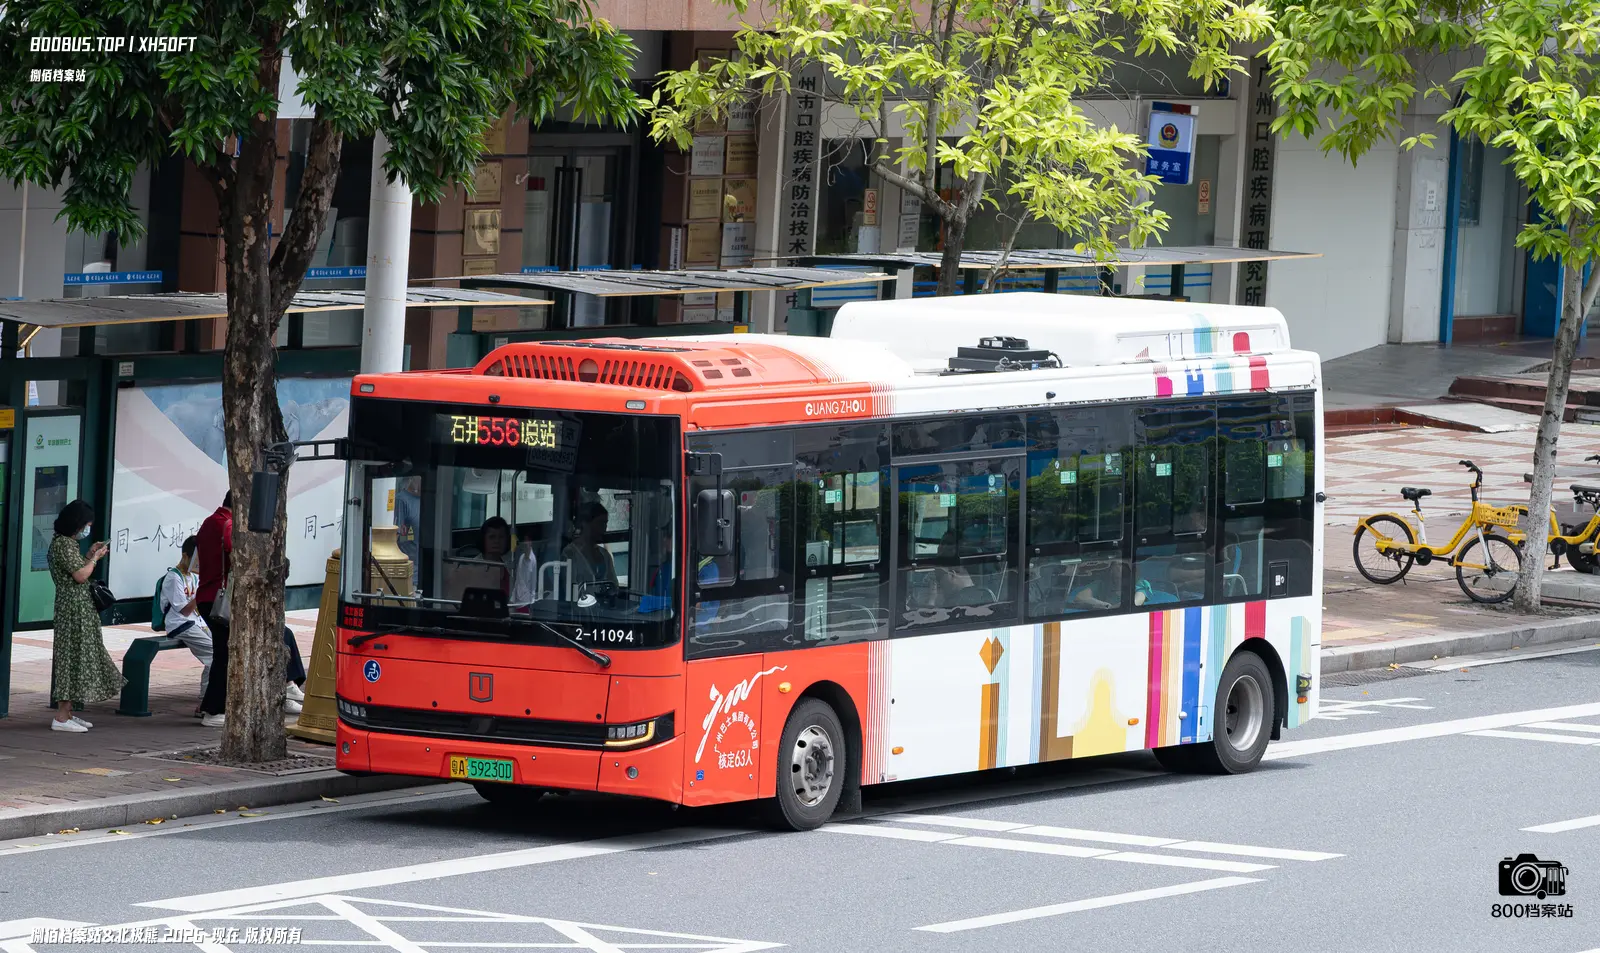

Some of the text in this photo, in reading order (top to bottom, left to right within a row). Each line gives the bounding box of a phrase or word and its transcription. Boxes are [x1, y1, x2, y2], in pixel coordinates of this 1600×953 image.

[1150, 160, 1181, 172] 警务室
[1246, 63, 1273, 306] 广州口腔疾病研究所
[805, 399, 866, 416] GUANGZHOU
[575, 628, 634, 643] 2-11094
[714, 711, 758, 754] 广州巴士集团有限公司
[718, 749, 753, 769] 核定63人
